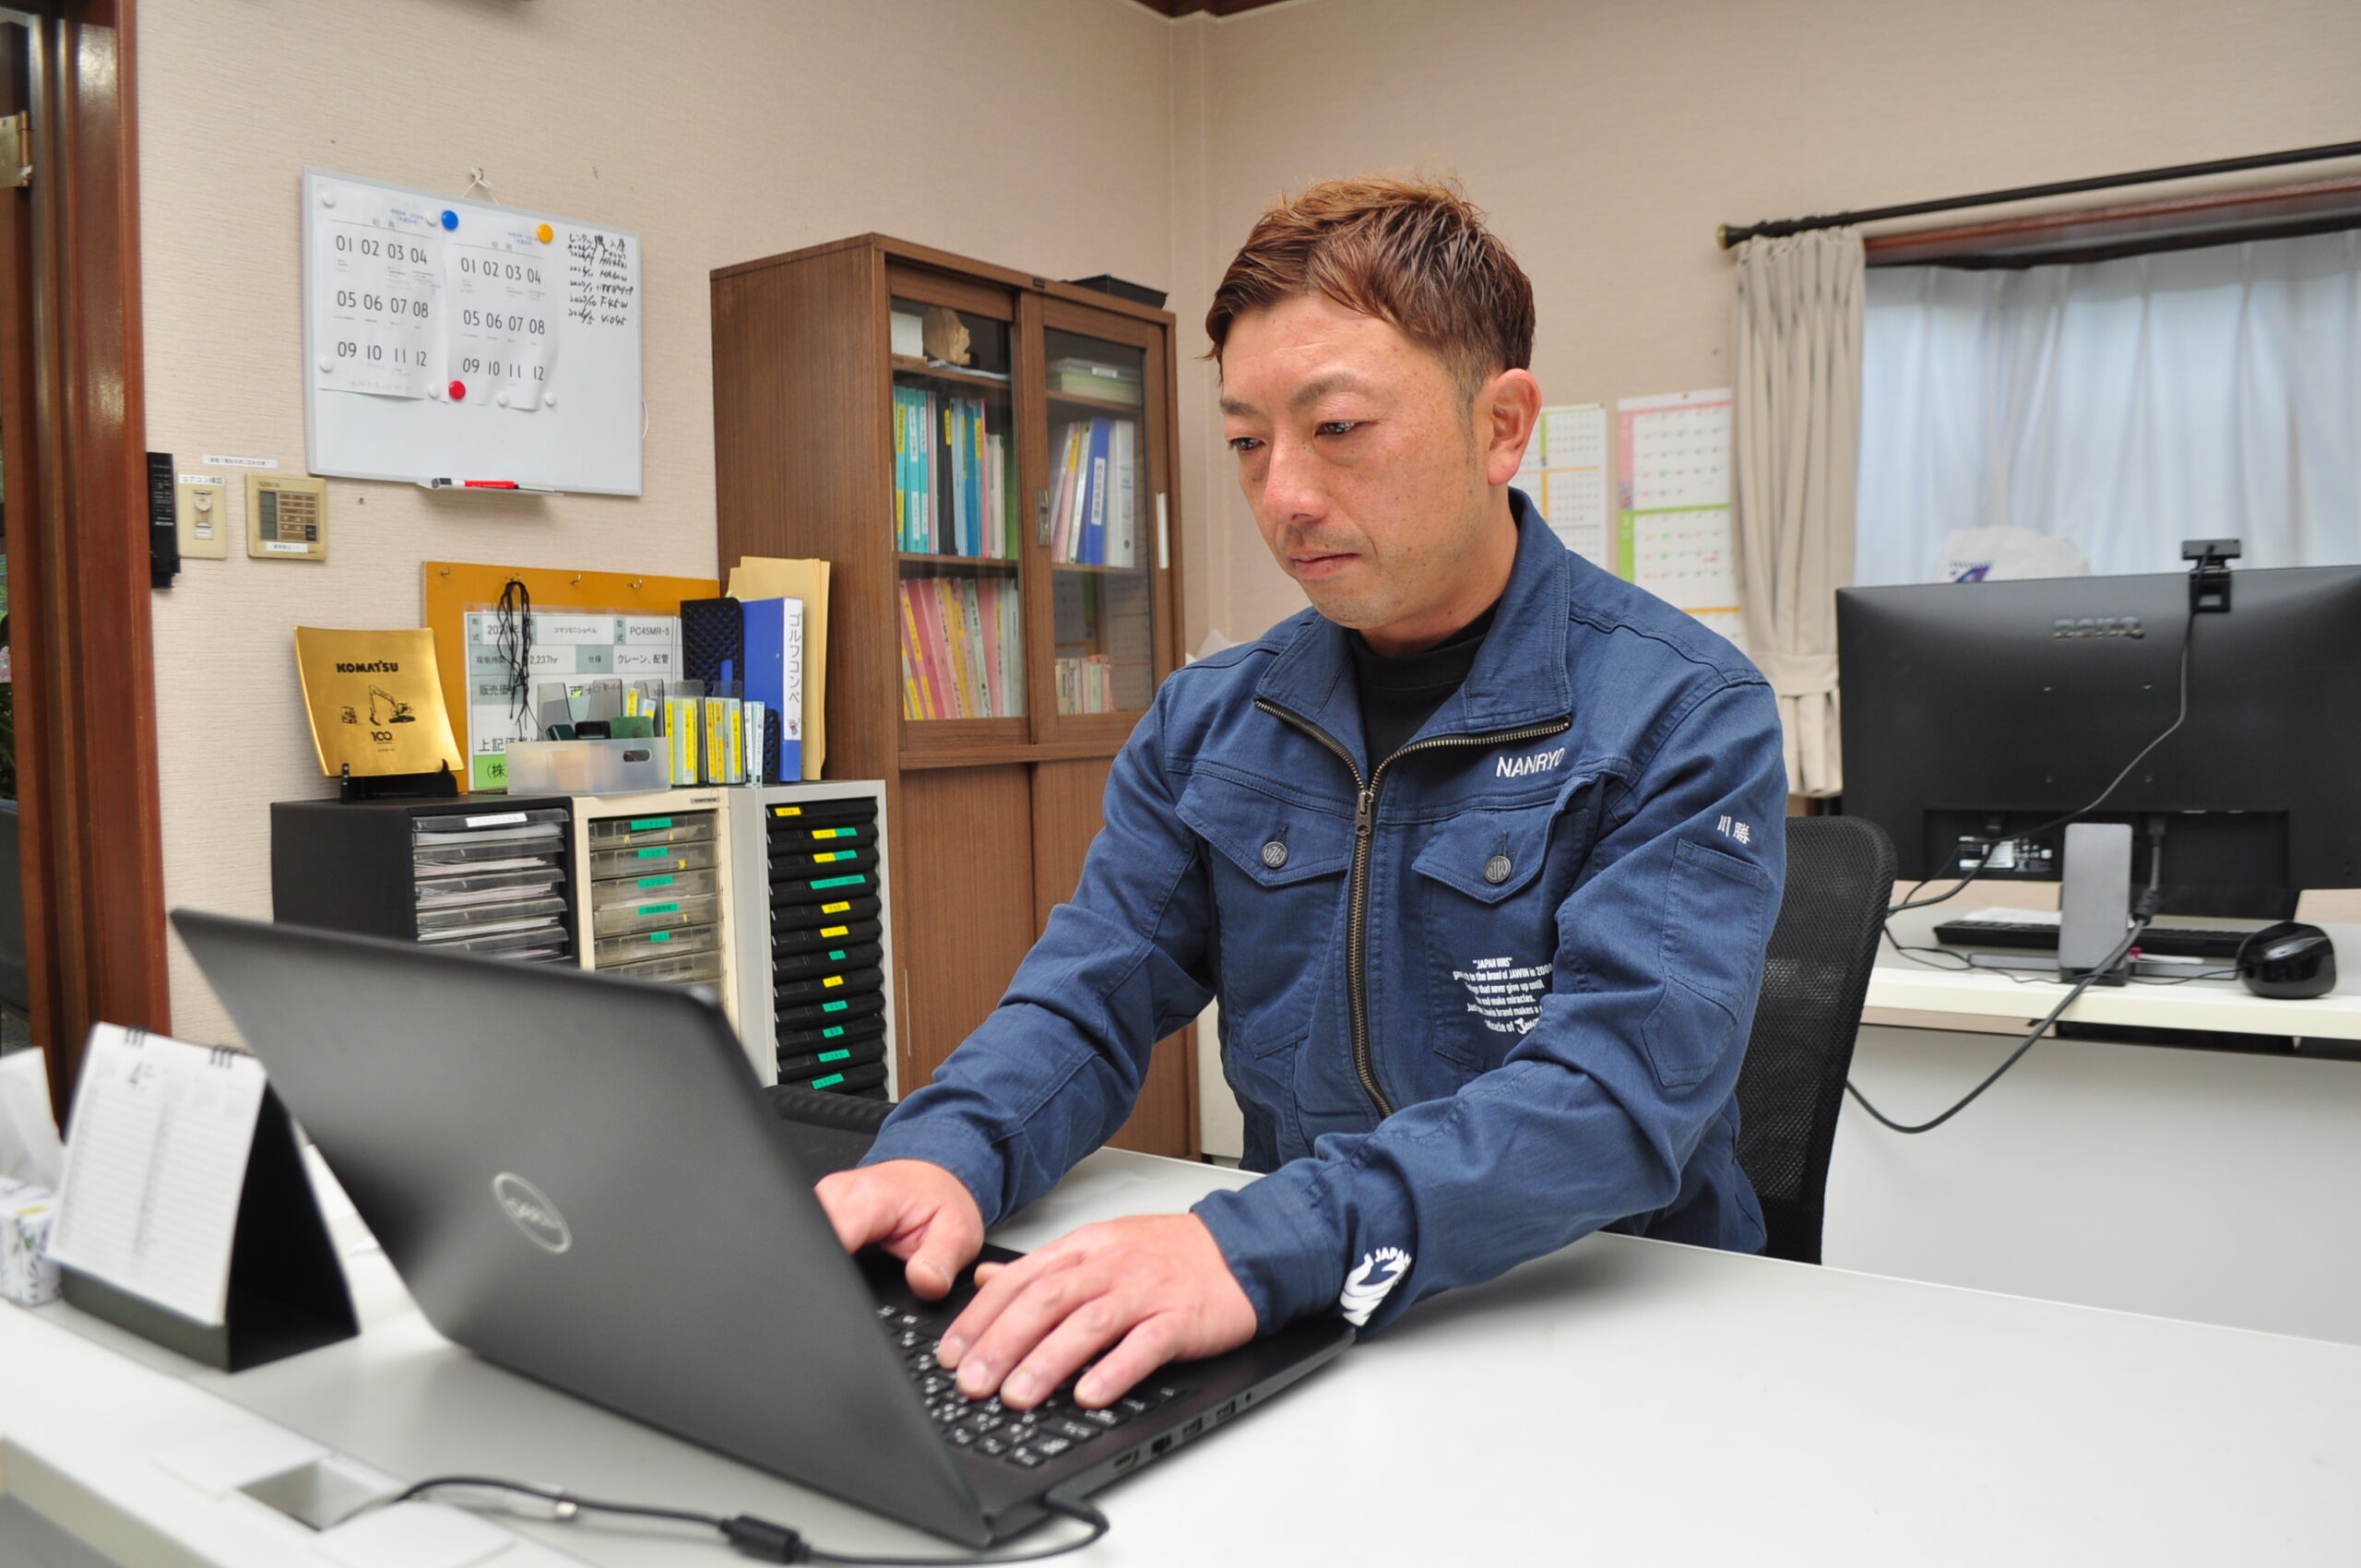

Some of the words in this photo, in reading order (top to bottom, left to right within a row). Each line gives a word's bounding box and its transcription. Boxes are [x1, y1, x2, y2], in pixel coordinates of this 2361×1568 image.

[336, 235, 352, 252] 01
[361, 239, 380, 256] 02
[386, 243, 405, 260] 03
[409, 247, 428, 265] 04
[460, 256, 476, 274] 01
[482, 260, 500, 278] 02
[505, 264, 522, 280] 03
[527, 267, 541, 285] 04
[337, 291, 357, 307] 05
[363, 293, 384, 312] 06
[390, 297, 408, 315] 07
[412, 301, 429, 319] 08
[463, 309, 481, 327] 05
[485, 312, 503, 330] 06
[508, 315, 524, 333] 07
[528, 318, 546, 336] 08
[337, 341, 358, 359] 09
[367, 344, 383, 362] 10
[395, 347, 407, 363] 11
[416, 350, 427, 367] 12
[462, 357, 481, 374] 09
[488, 361, 501, 377] 10
[509, 363, 522, 379] 11
[533, 365, 544, 382] 12
[629, 626, 670, 636] PC45MR-5
[336, 659, 399, 673] KOMATSU
[617, 654, 670, 665] クレーン、配管
[789, 613, 801, 704] ゴルフコンペ
[370, 731, 394, 742] 100
[1496, 747, 1565, 778] NANRYO
[1476, 971, 1487, 981] the
[1487, 970, 1502, 980] brand
[1478, 984, 1490, 994] that
[1490, 984, 1506, 993] never
[1506, 982, 1520, 994] give
[1520, 981, 1529, 992] up
[1529, 979, 1545, 991] until
[1491, 995, 1506, 1005] make
[1496, 1007, 1513, 1017] brand
[1513, 1005, 1534, 1016] makes
[1506, 1020, 1514, 1032] of
[1375, 1247, 1412, 1267] JAPAN
